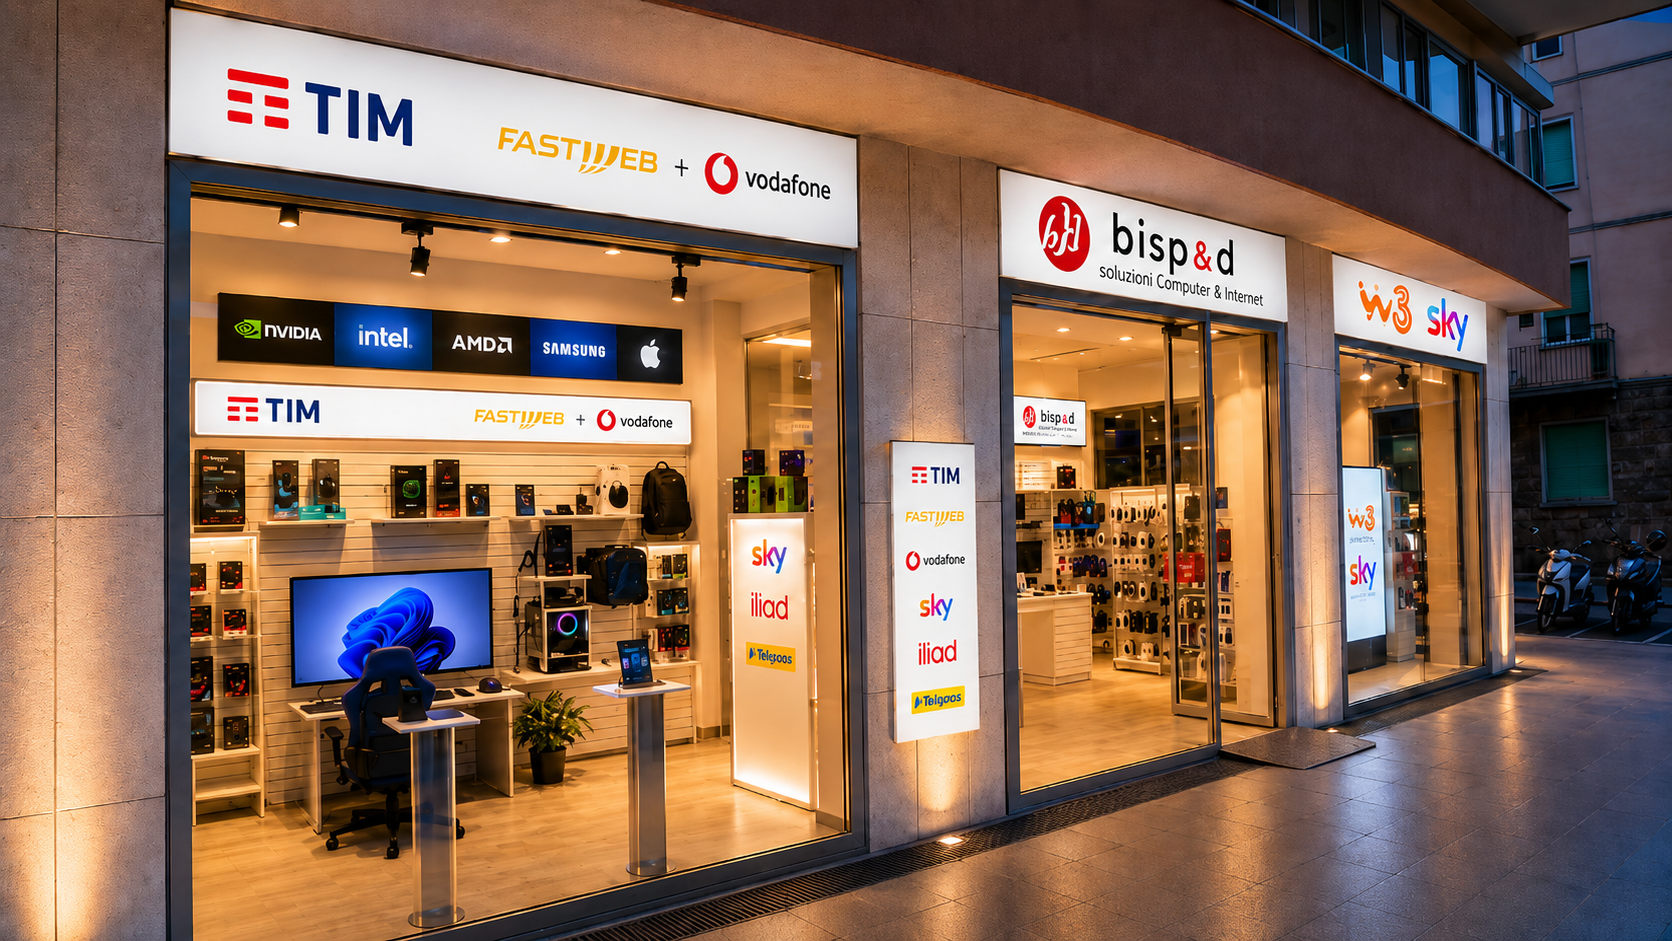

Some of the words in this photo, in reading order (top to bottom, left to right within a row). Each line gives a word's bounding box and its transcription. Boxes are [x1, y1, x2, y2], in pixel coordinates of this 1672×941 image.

[304, 82, 413, 147] TIM
[498, 127, 658, 175] FASTWEB
[745, 170, 831, 201] vodafone
[1113, 212, 1234, 276] bisp&d
[1099, 265, 1153, 287] soluzioni
[1156, 274, 1211, 296] Computer
[1214, 285, 1222, 299] &
[1225, 287, 1264, 307] Internet
[264, 323, 323, 341] NVIDIA
[358, 324, 408, 349] intel
[1427, 298, 1469, 352] sky
[452, 334, 497, 353] AMD
[542, 341, 606, 358] SAMSUNG
[265, 398, 320, 424] TIM
[474, 408, 565, 430] FASTWEB
[620, 415, 674, 429] vodafone
[930, 466, 961, 485] TIM
[905, 511, 965, 527] FASTWEB
[752, 538, 788, 574] sky
[923, 553, 966, 566] vodafone
[1350, 555, 1377, 591] sky
[751, 591, 789, 621] iliad
[919, 592, 954, 621] sky
[918, 639, 957, 666] iliad
